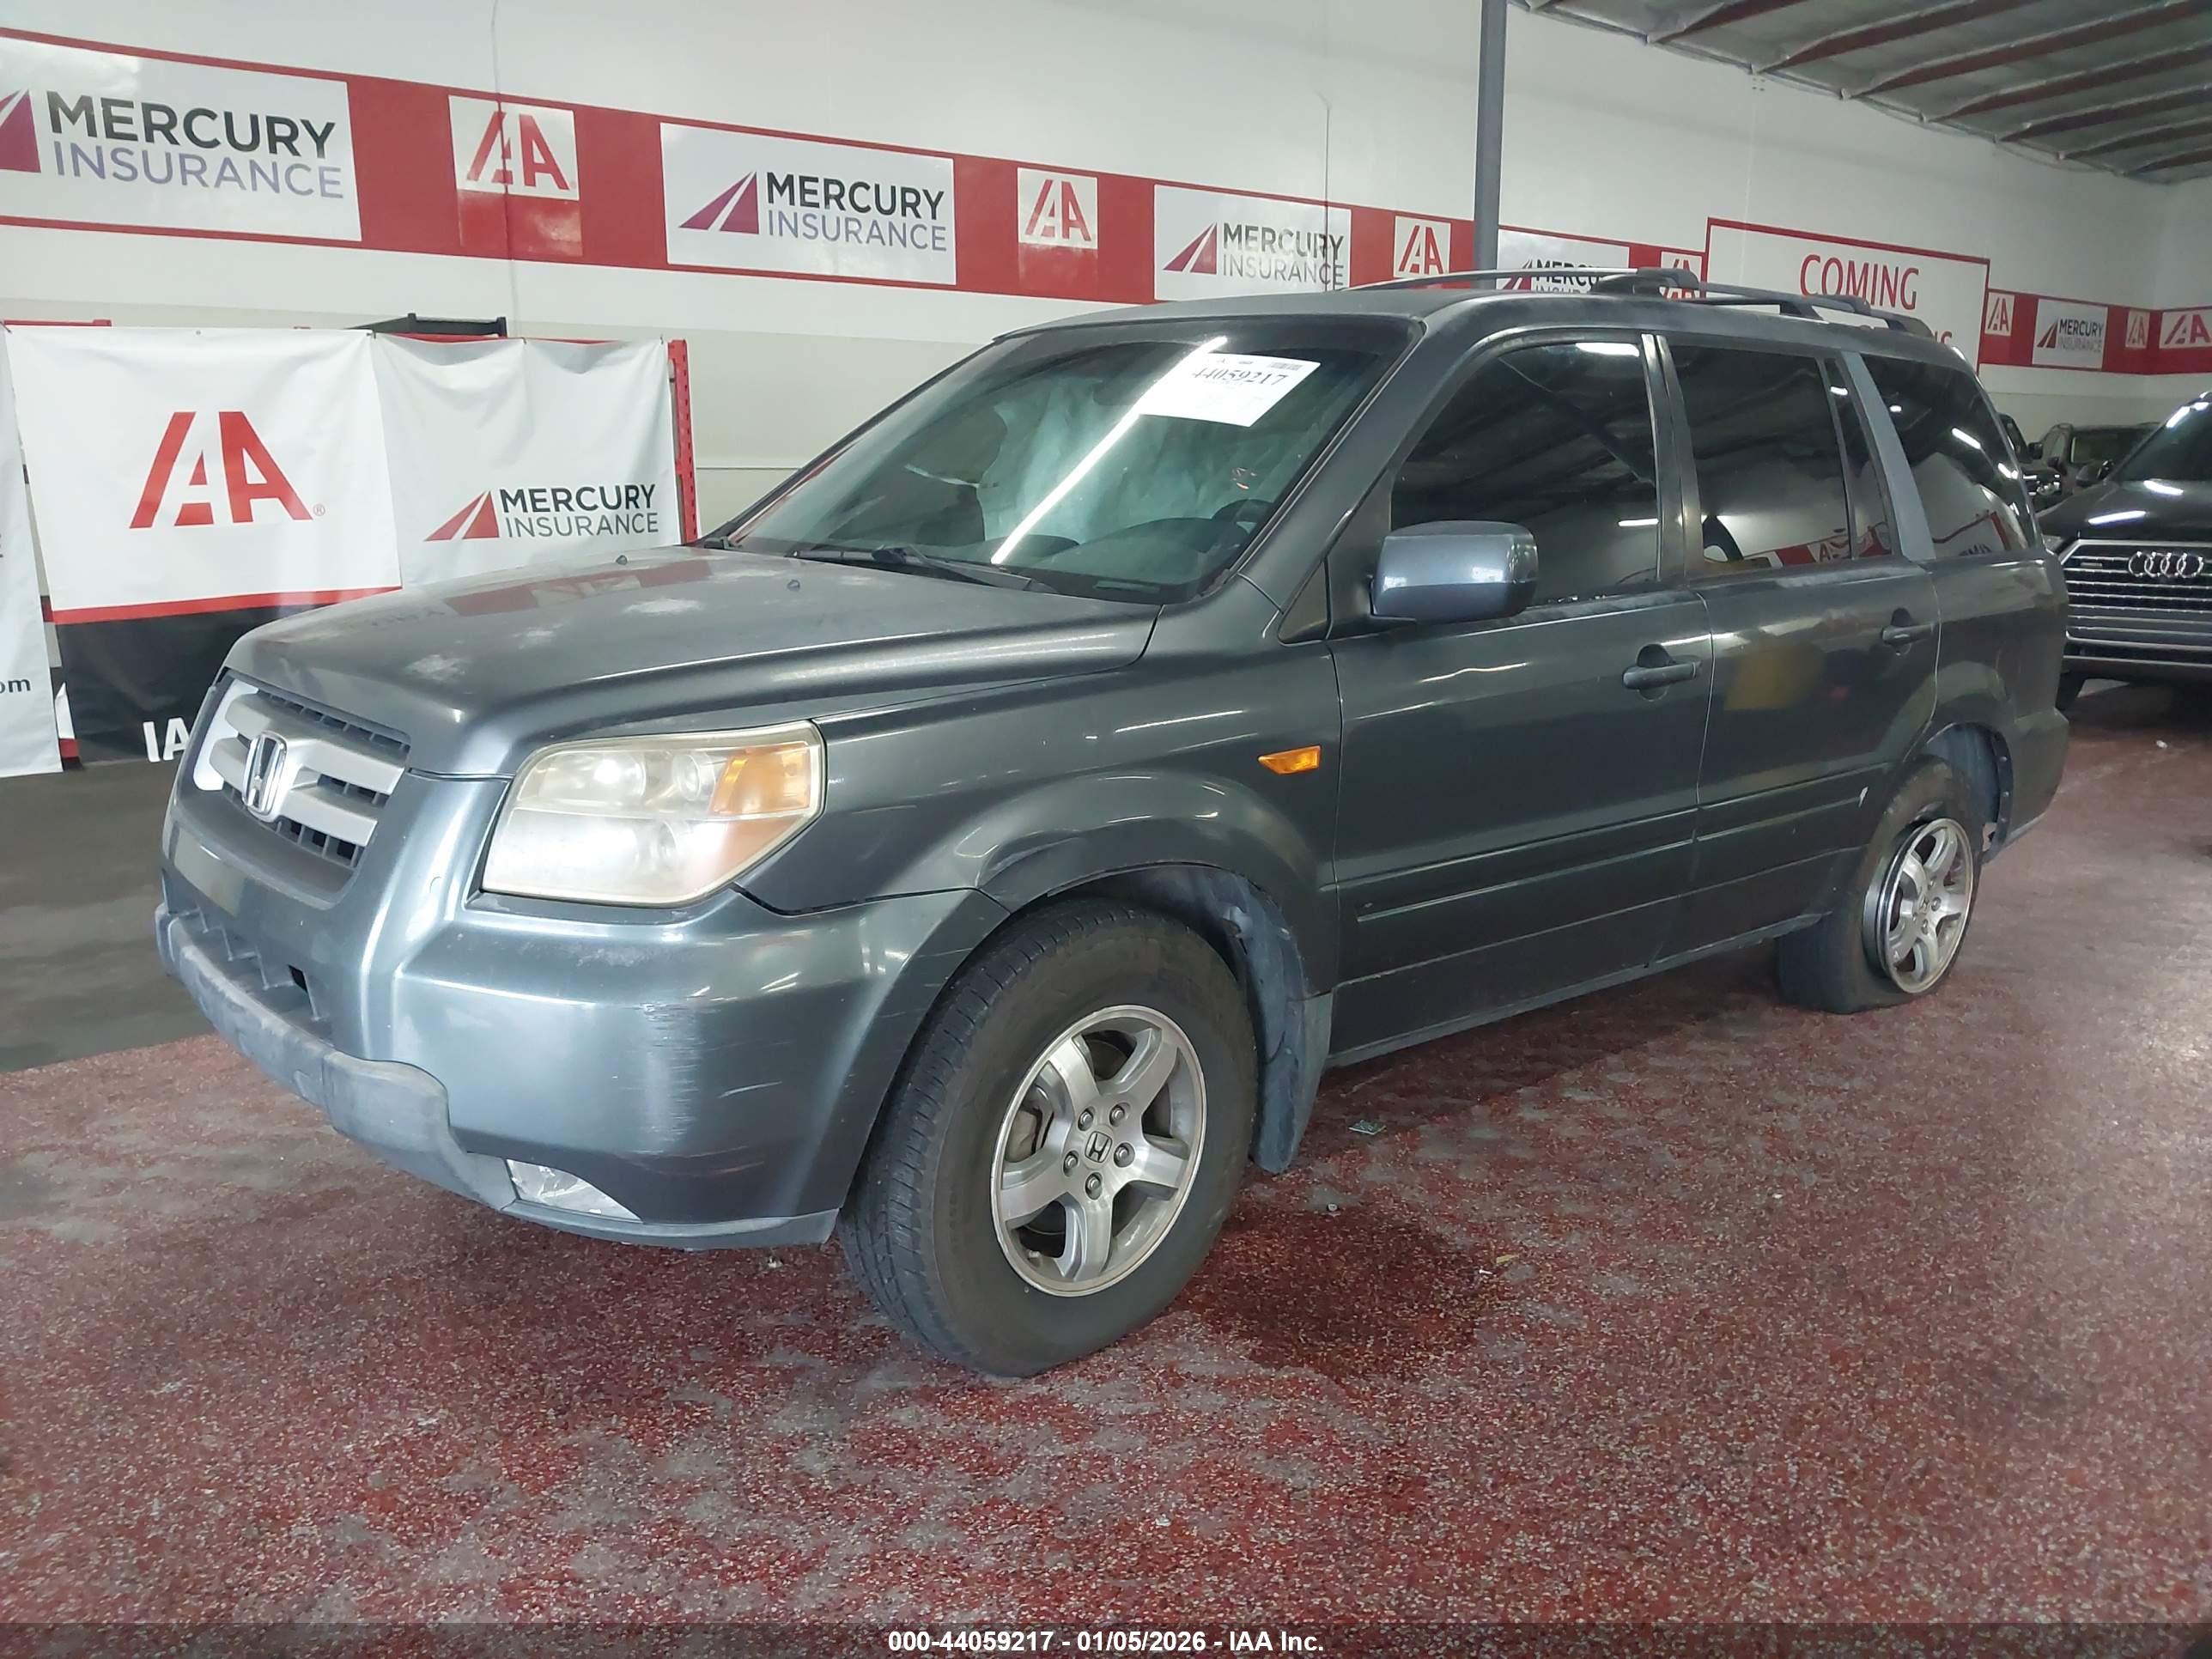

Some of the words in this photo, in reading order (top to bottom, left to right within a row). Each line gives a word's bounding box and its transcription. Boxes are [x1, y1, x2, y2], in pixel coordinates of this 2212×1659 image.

[47, 91, 336, 159] MERCURY
[53, 140, 343, 199] INSURANCE
[767, 172, 945, 221] MERCURY
[769, 210, 947, 252] INSURANCE
[1224, 222, 1345, 260] MERCURY
[1224, 254, 1345, 286] INSURANCE
[1800, 254, 1919, 310] COMING
[2059, 319, 2102, 337] MERCURY
[1192, 368, 1289, 385] 44059217
[499, 483, 656, 514] MERCURY
[505, 513, 659, 538] INSURANCE
